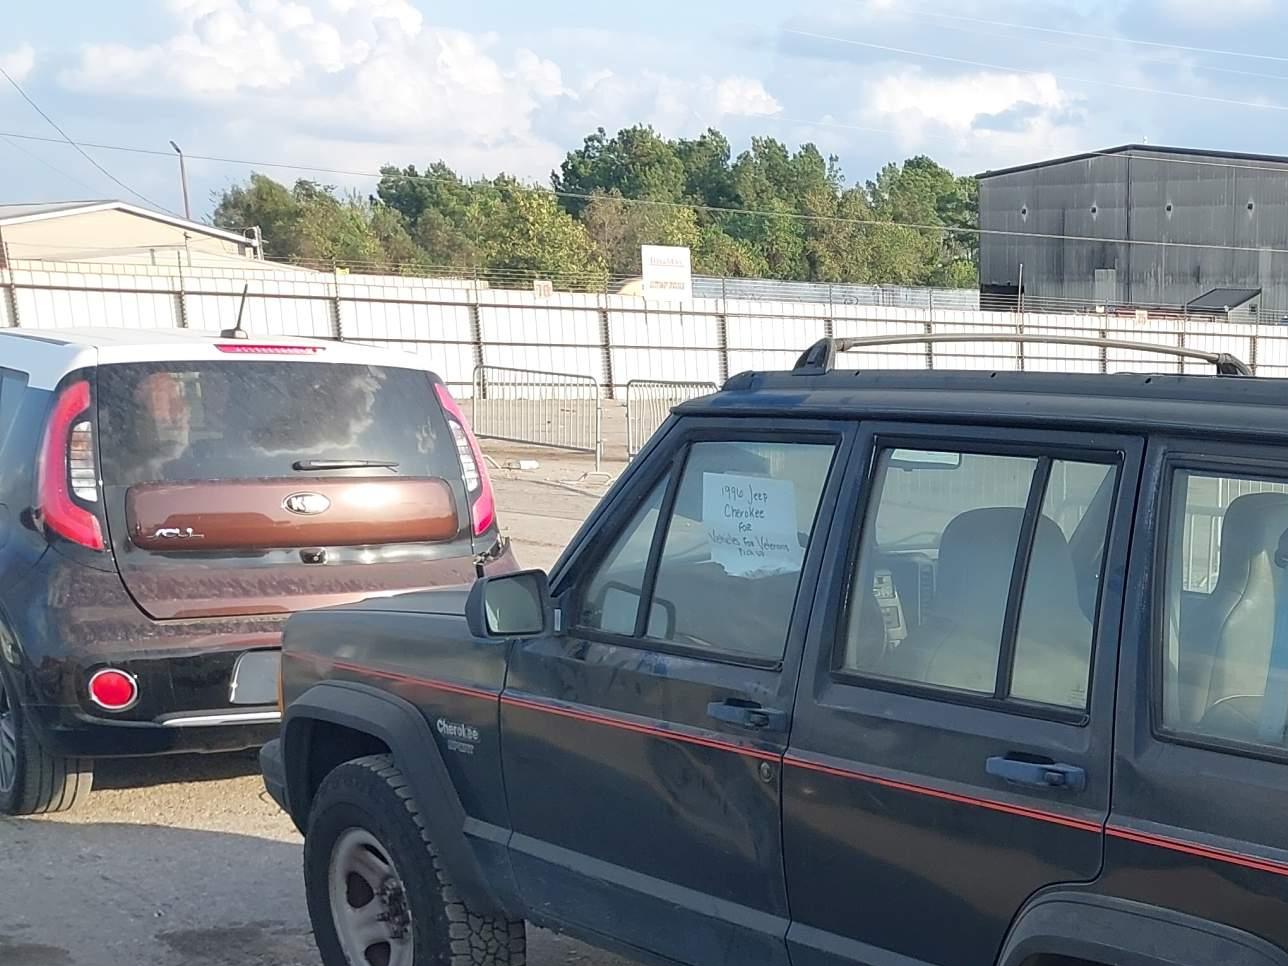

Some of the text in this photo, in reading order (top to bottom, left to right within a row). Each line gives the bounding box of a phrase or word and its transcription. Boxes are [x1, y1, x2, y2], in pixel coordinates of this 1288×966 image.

[721, 484, 768, 504] 1996 Jeep
[724, 504, 765, 520] Cherokee
